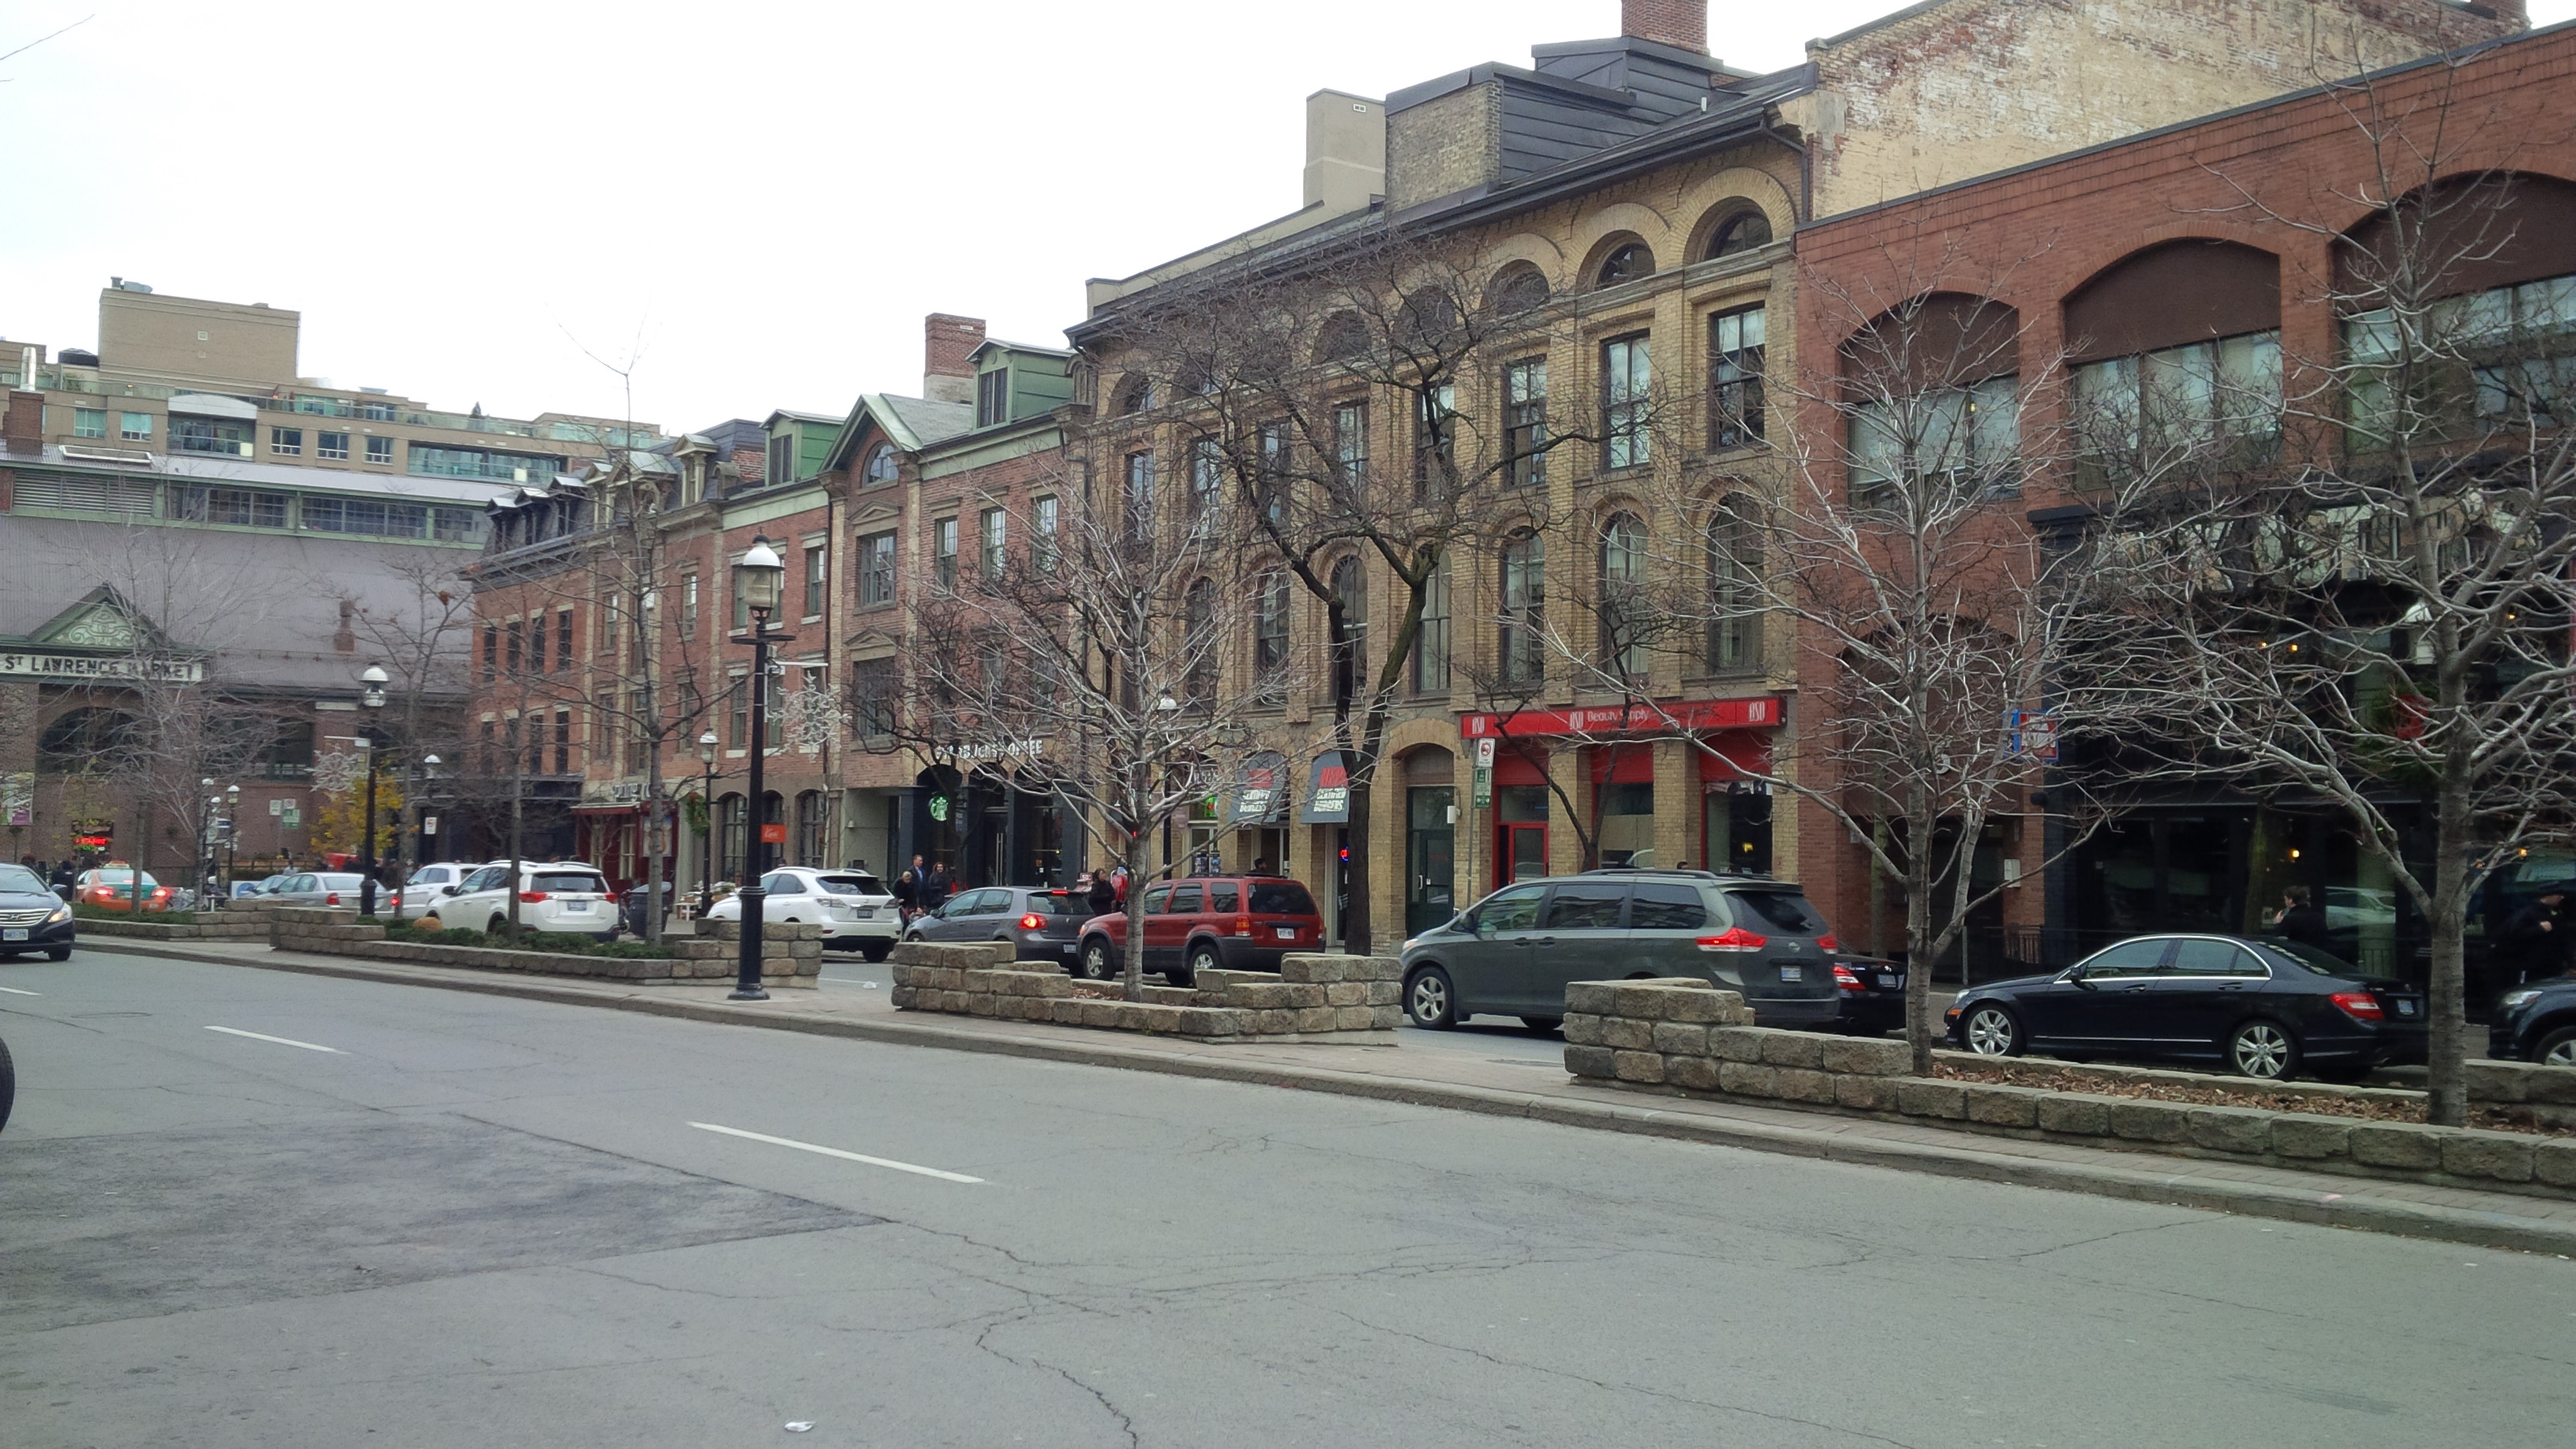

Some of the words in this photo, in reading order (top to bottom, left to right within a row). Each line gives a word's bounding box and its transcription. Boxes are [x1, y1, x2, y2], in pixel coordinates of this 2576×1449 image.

[31, 656, 118, 673] LAWRENCE
[126, 660, 193, 679] MRKET
[1587, 710, 1619, 721] Beauty
[1619, 708, 1649, 721] Spply
